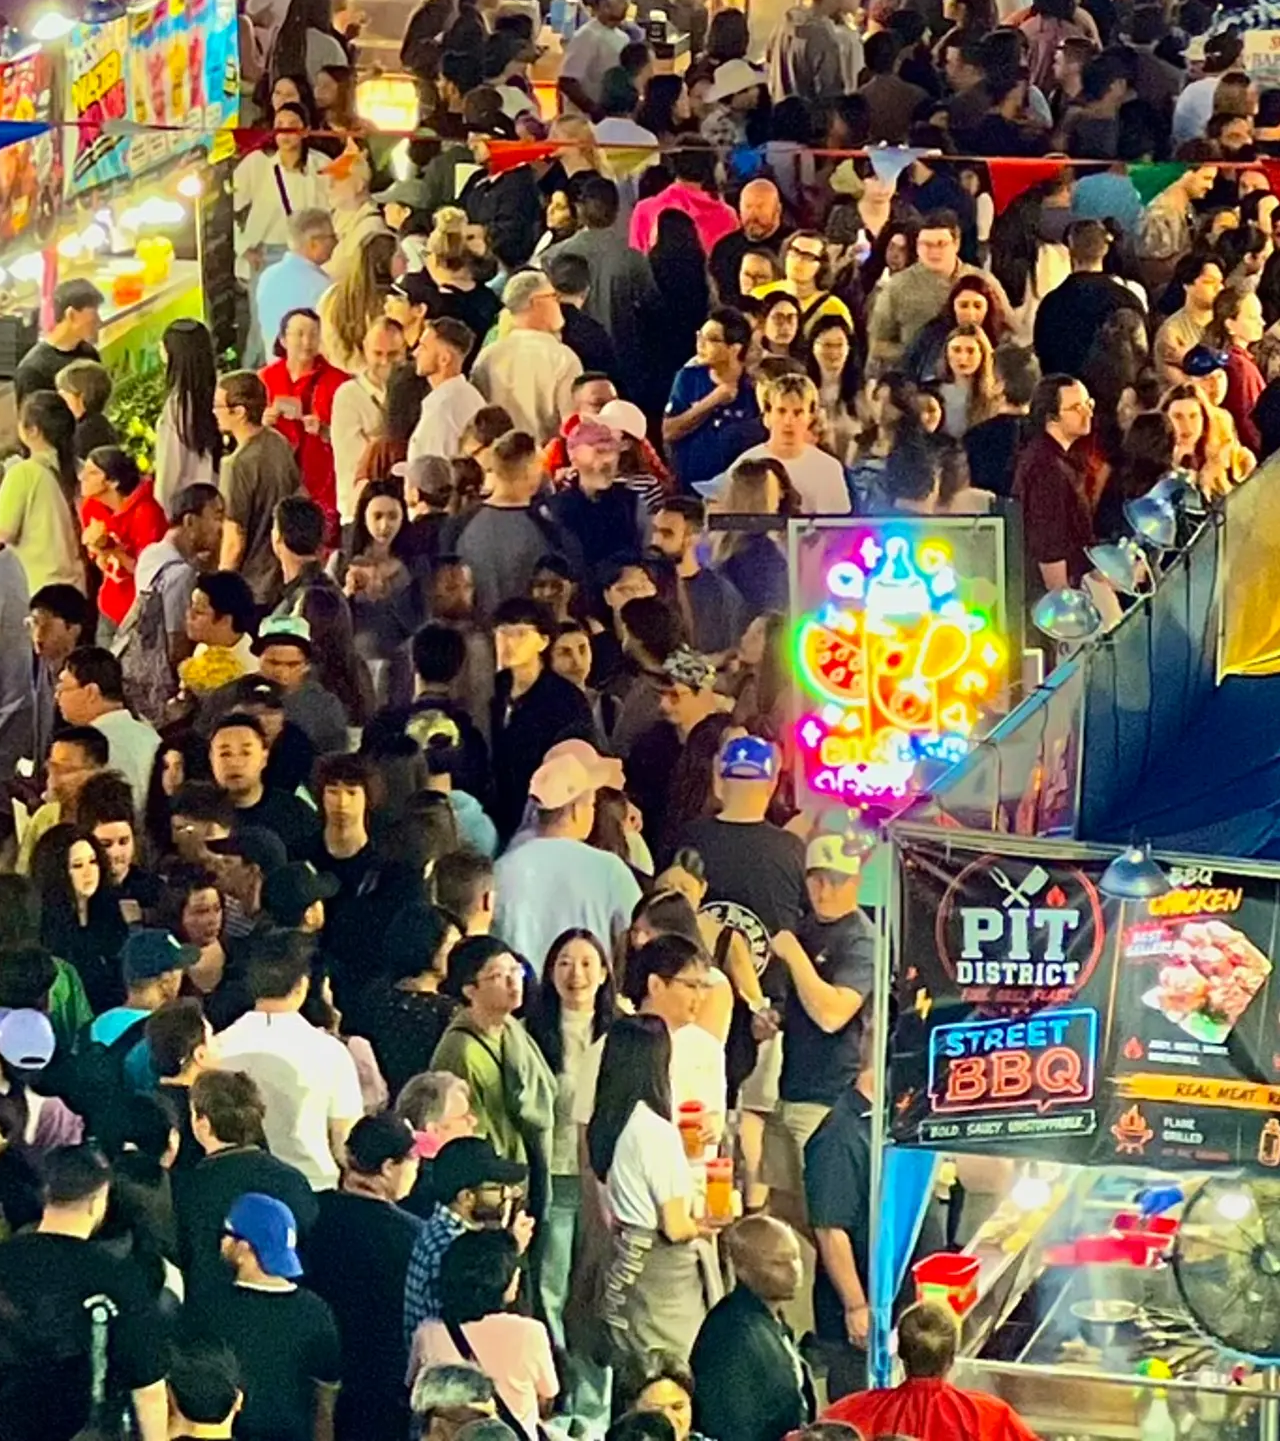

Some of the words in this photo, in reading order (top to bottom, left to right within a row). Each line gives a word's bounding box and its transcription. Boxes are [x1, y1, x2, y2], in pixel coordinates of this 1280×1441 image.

[1169, 867, 1214, 885] BBQ
[1148, 887, 1244, 916] CHICKEN
[959, 908, 1080, 962] PIT
[957, 961, 1080, 986] DISTRICT
[946, 1019, 1070, 1056] STREET
[946, 1047, 1084, 1101] BBQ
[1175, 1082, 1211, 1098] REAL
[1219, 1085, 1257, 1103] MEAT.
